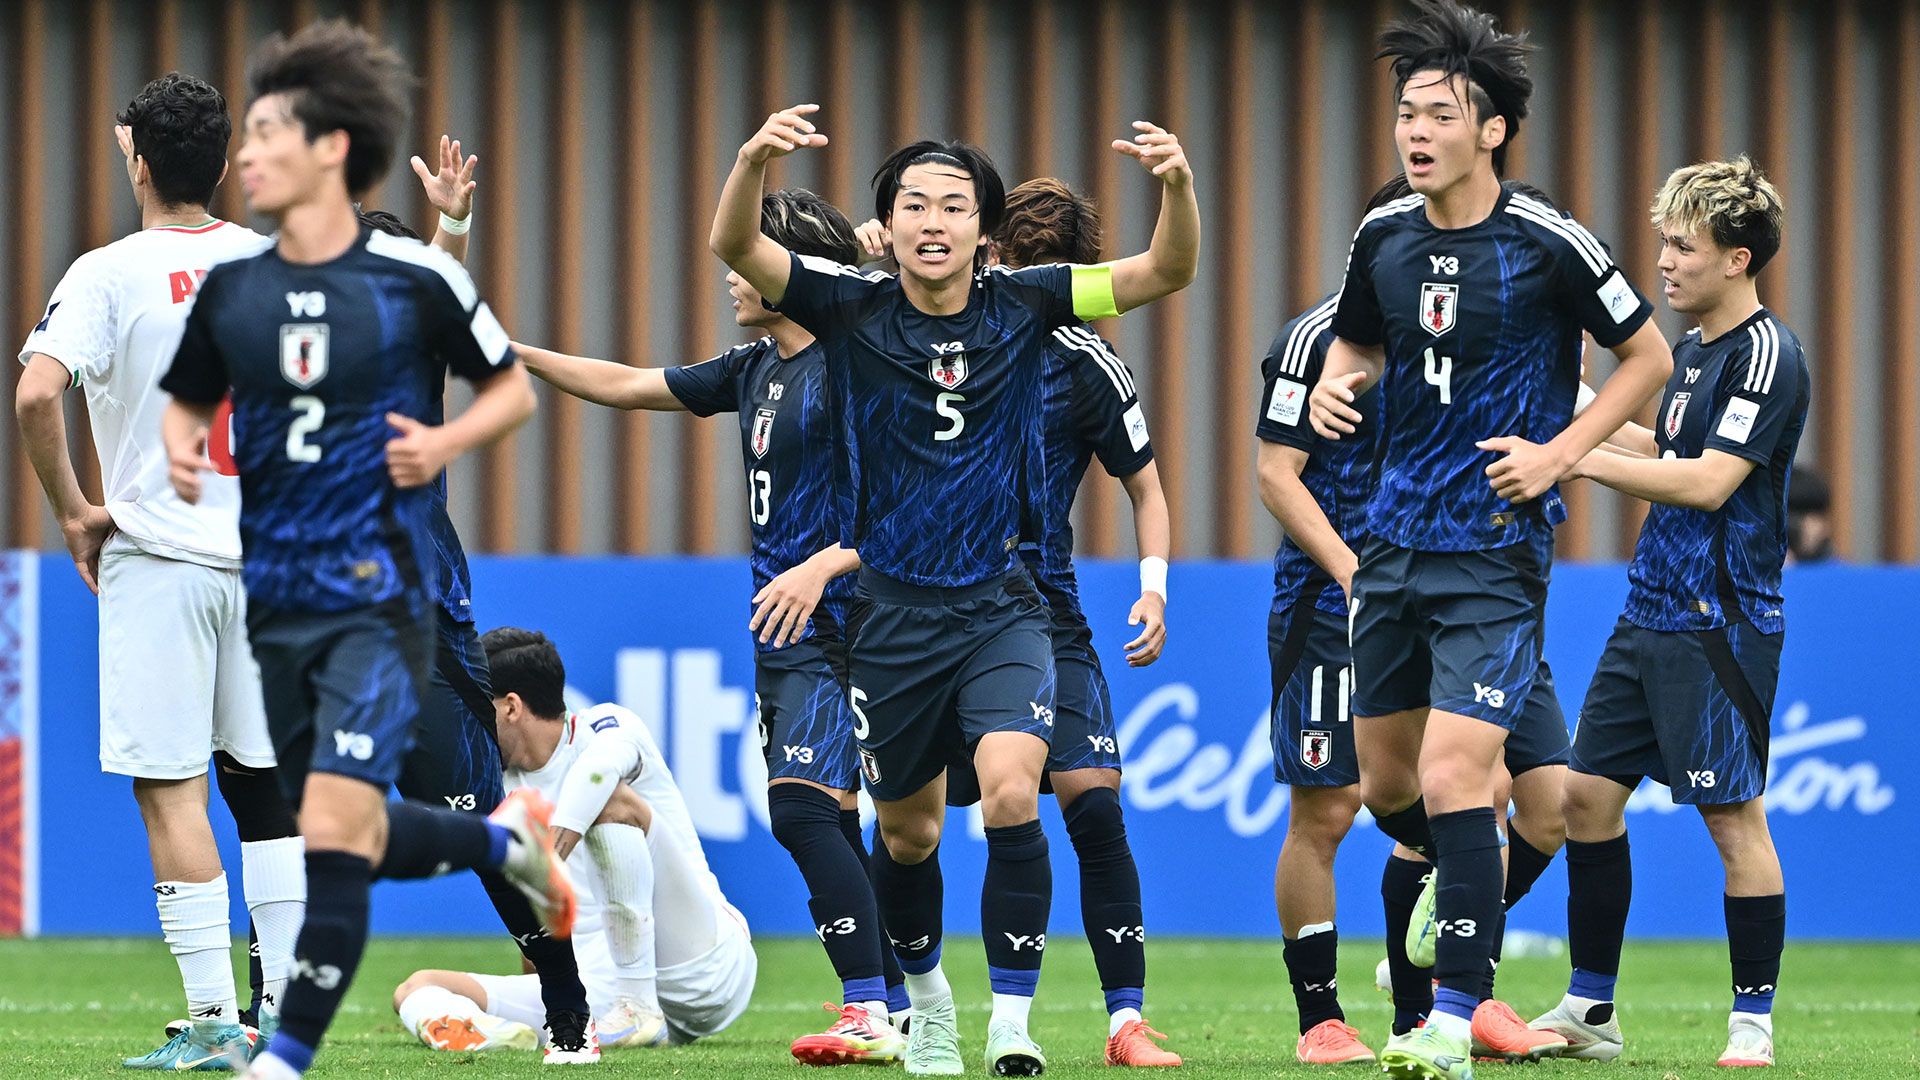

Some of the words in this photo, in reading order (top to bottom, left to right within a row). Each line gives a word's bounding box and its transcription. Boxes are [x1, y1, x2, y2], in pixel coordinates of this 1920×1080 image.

[1429, 255, 1459, 275] Y-3
[169, 269, 209, 304] A
[1424, 347, 1453, 405] 4
[934, 392, 966, 441] 5
[1726, 413, 1749, 426] AFC
[286, 396, 326, 463] 2
[749, 468, 772, 526] 13
[1473, 682, 1506, 709] Y-3
[850, 686, 870, 741] 5
[1029, 701, 1054, 727] Y-3
[782, 745, 814, 764] Y-3
[1087, 735, 1116, 754] Y-3
[1686, 770, 1716, 788] Y-3
[444, 794, 476, 811] Y-3
[815, 917, 857, 943] Y-3
[1105, 926, 1145, 944] Y-3
[1435, 918, 1477, 938] Y-3
[1003, 932, 1046, 951] Y-3
